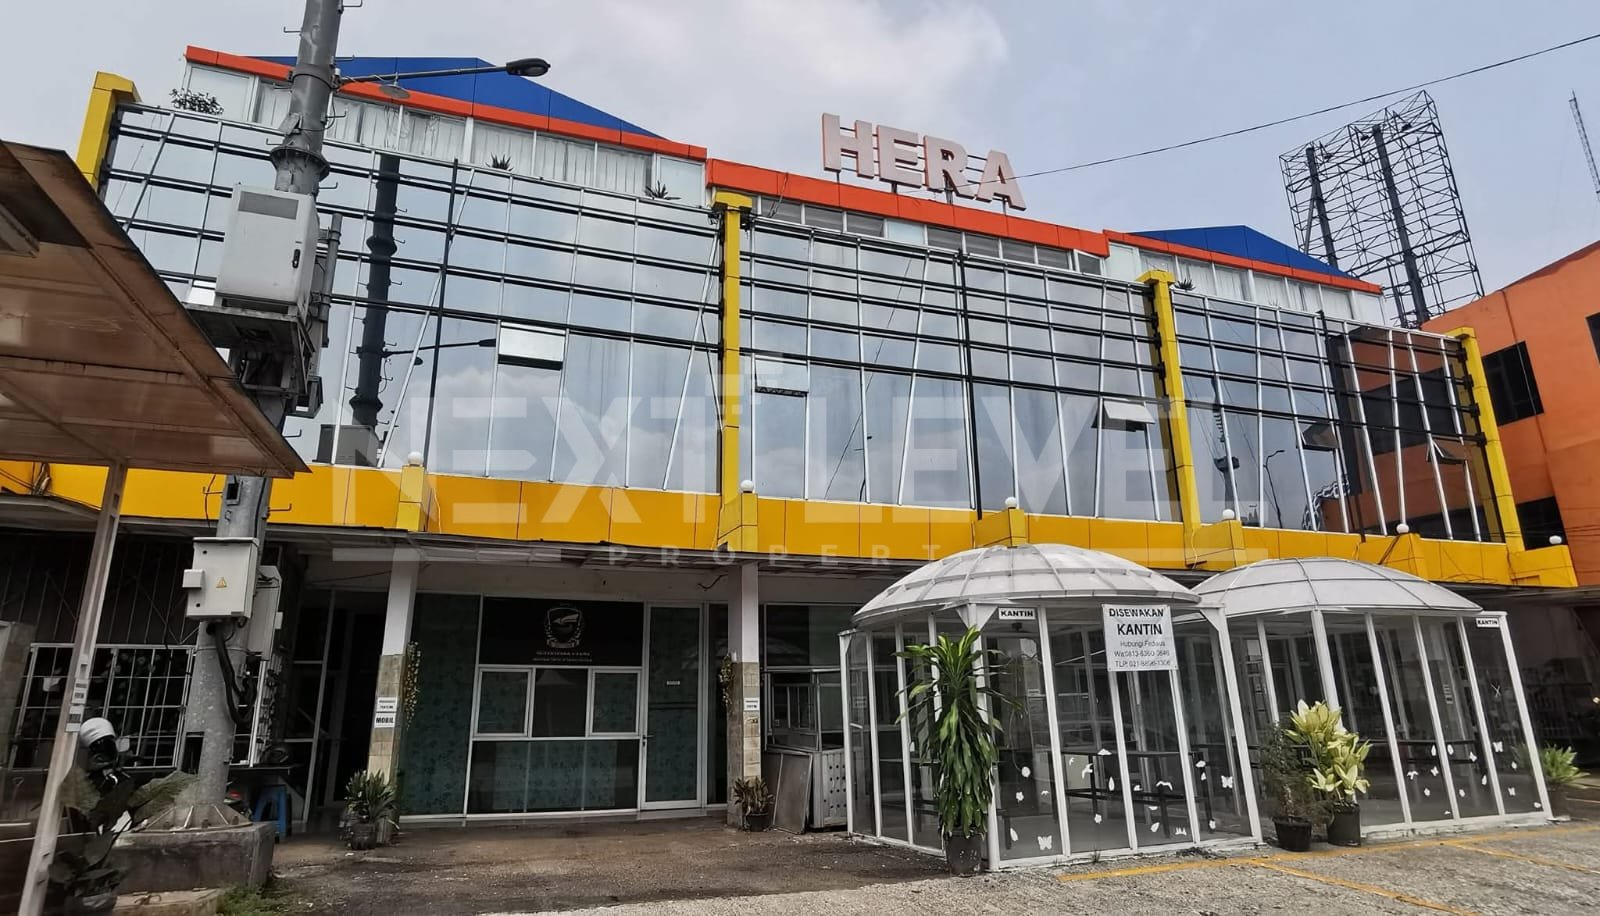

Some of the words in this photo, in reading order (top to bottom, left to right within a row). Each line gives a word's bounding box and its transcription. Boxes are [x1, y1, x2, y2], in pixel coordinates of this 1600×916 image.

[822, 113, 1027, 211] HERA
[1109, 608, 1164, 617] DISEWAKAN
[1117, 623, 1163, 636] KANTIN
